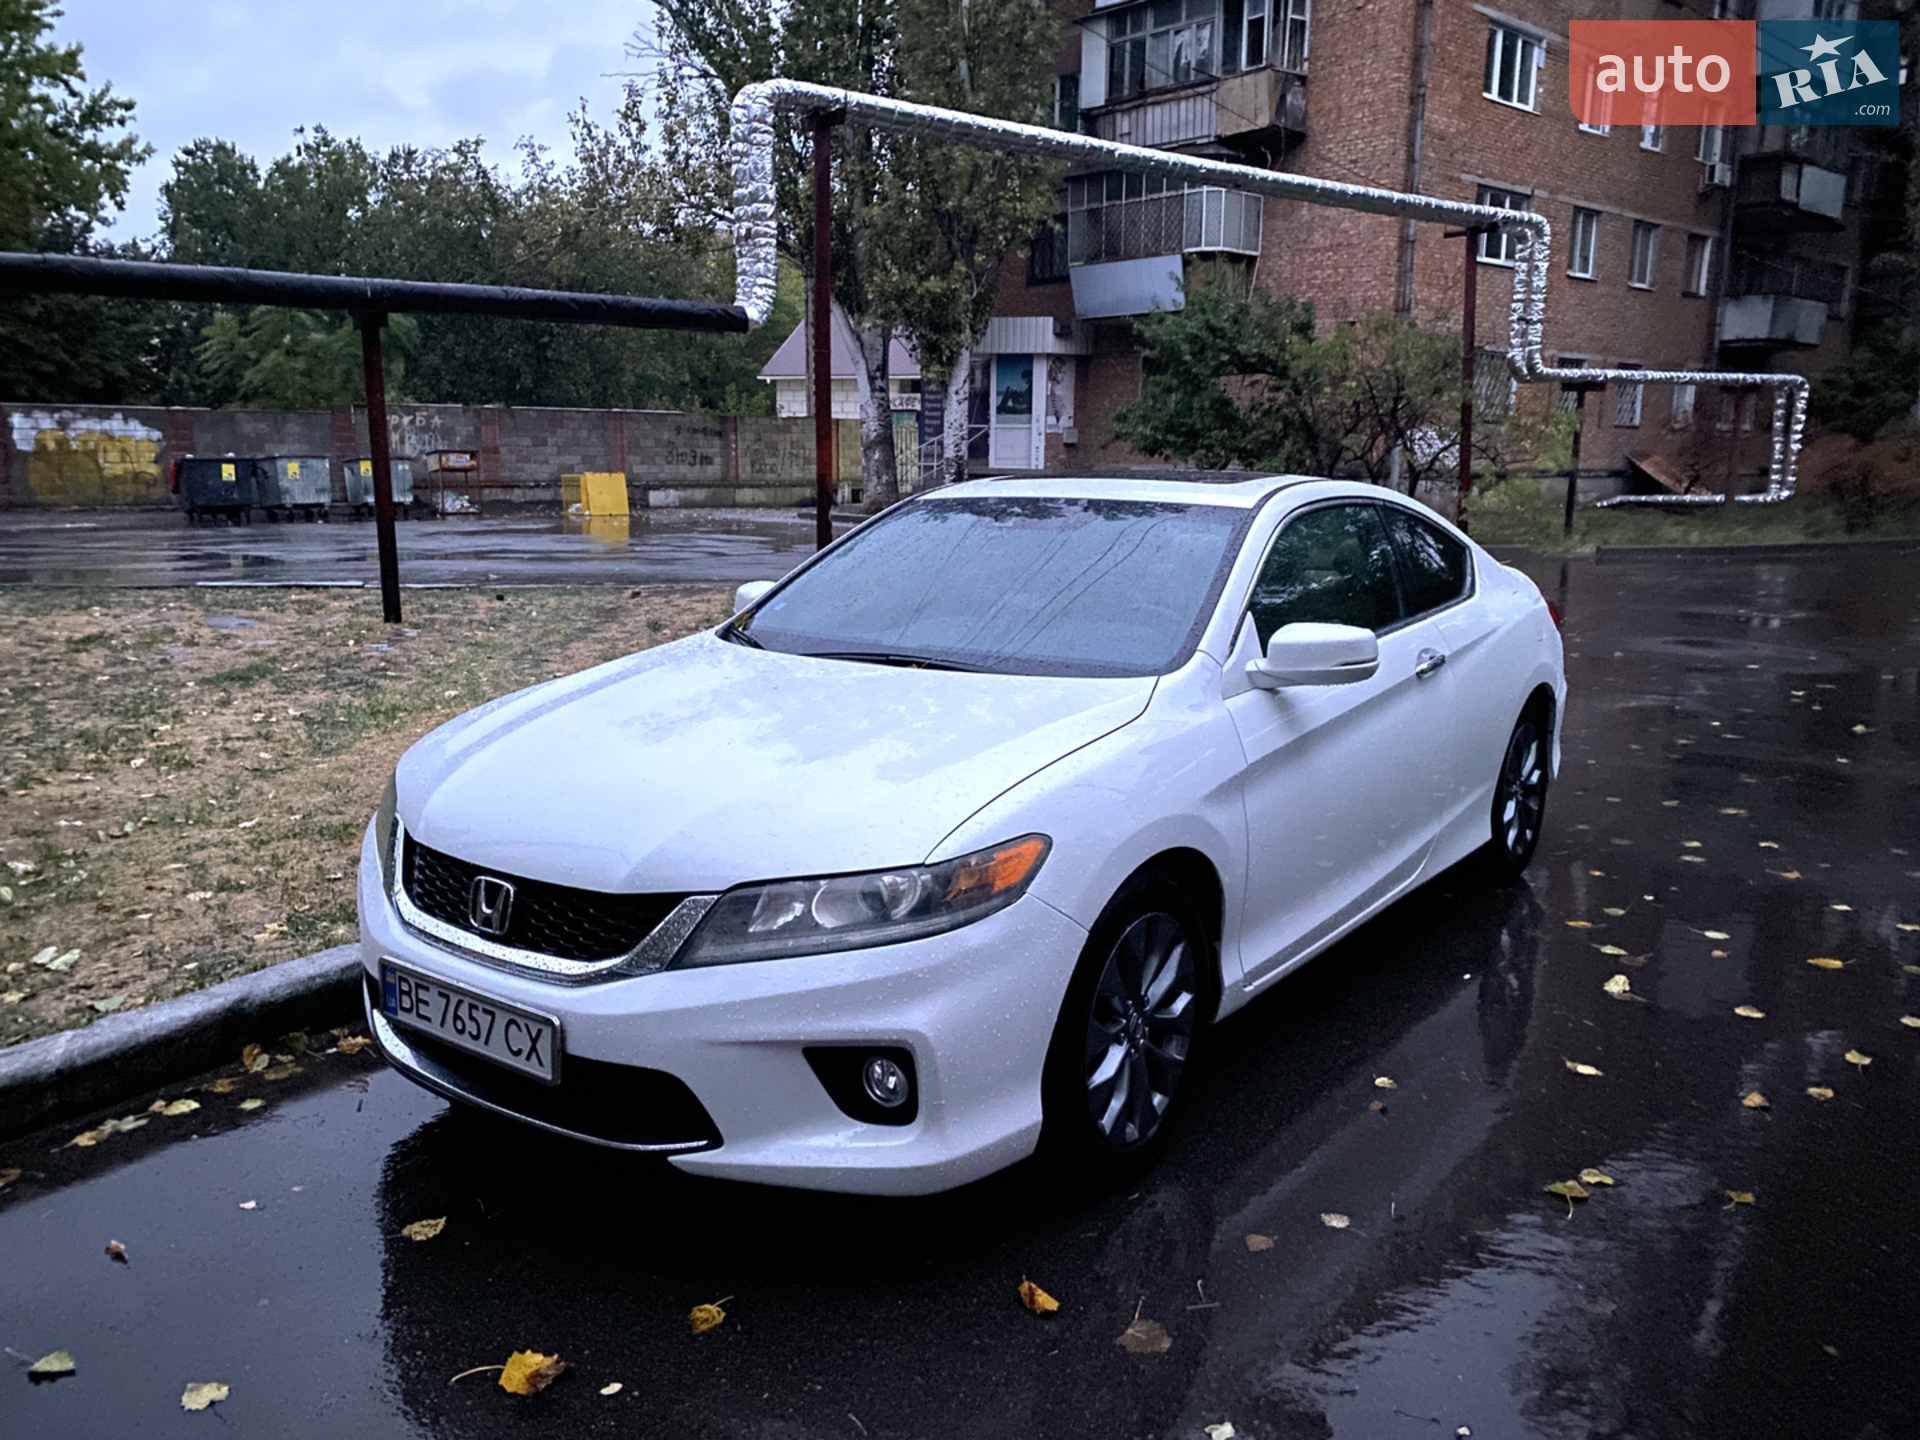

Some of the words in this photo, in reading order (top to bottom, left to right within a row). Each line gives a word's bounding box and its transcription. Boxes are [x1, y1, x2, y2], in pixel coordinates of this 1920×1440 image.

[398, 976, 432, 1023] BE
[436, 991, 497, 1046] 7657
[504, 1018, 545, 1068] CX
